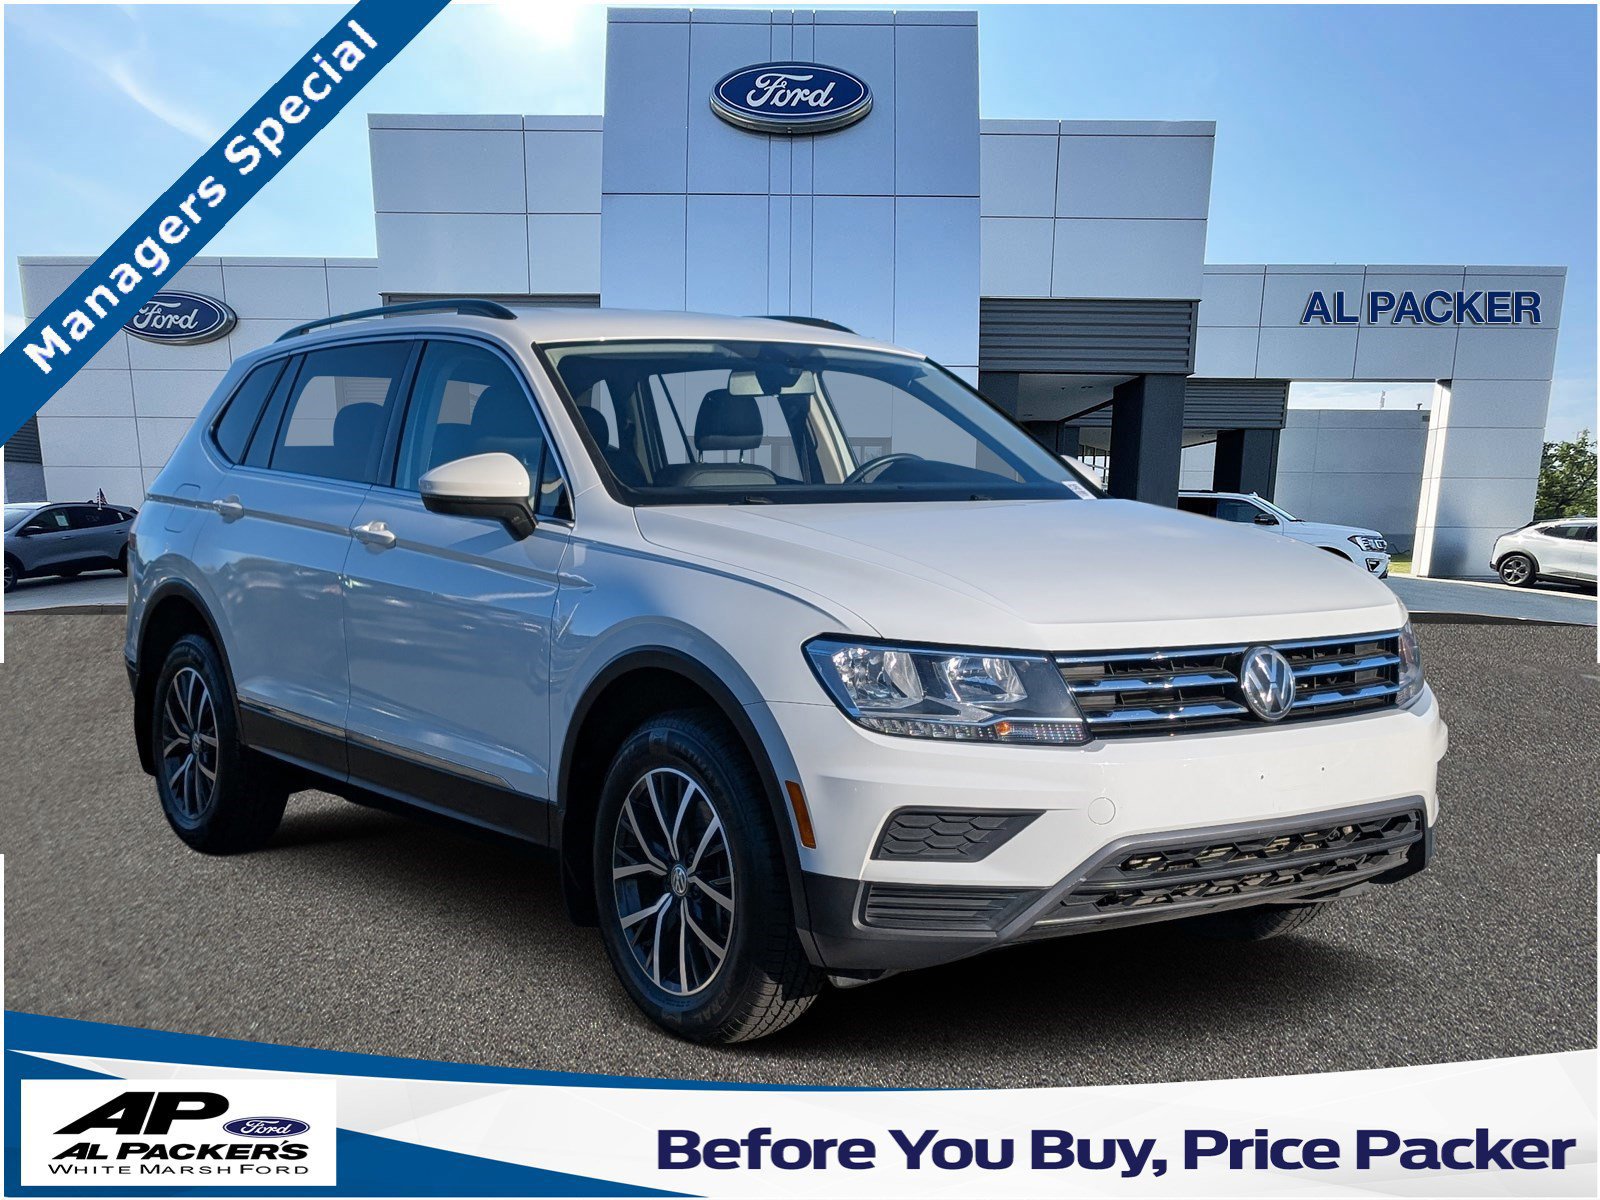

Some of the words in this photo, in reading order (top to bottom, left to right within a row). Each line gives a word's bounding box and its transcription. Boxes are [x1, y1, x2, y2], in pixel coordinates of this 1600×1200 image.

[746, 72, 836, 107] Ford
[133, 301, 199, 329] Ford
[1302, 290, 1360, 325] AL
[1368, 290, 1542, 325] PACKER
